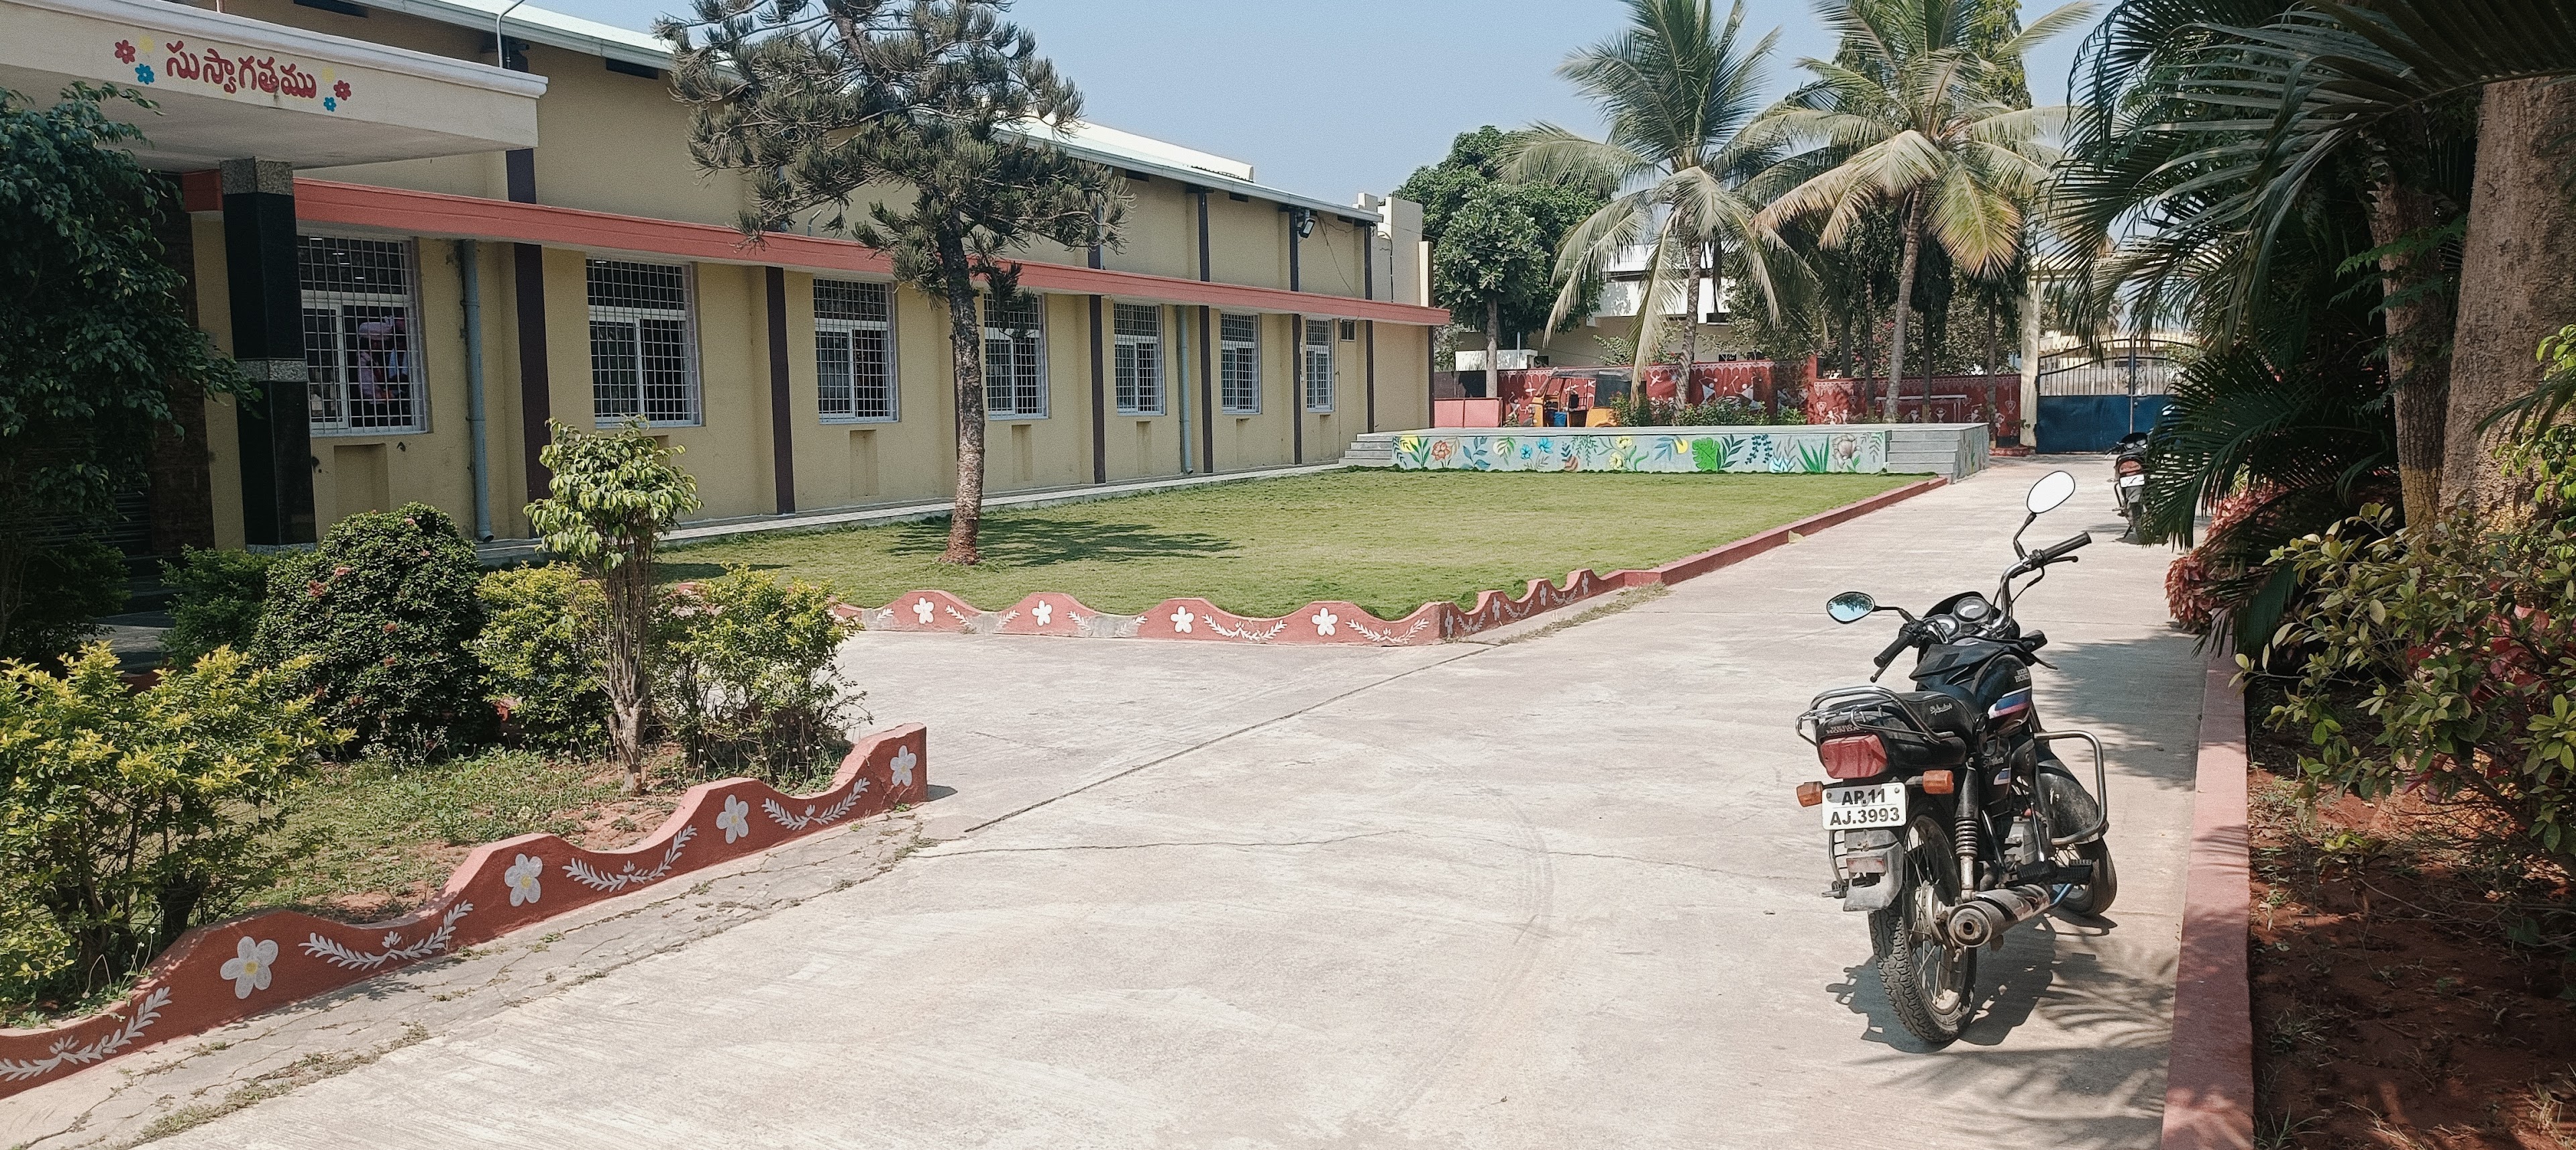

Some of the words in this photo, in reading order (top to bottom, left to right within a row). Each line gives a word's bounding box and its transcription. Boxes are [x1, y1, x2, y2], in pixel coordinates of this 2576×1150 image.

[166, 40, 317, 99] సుస్వాగతము
[1841, 788, 1885, 805] AP.11
[1830, 807, 1900, 825] AJ.3993
